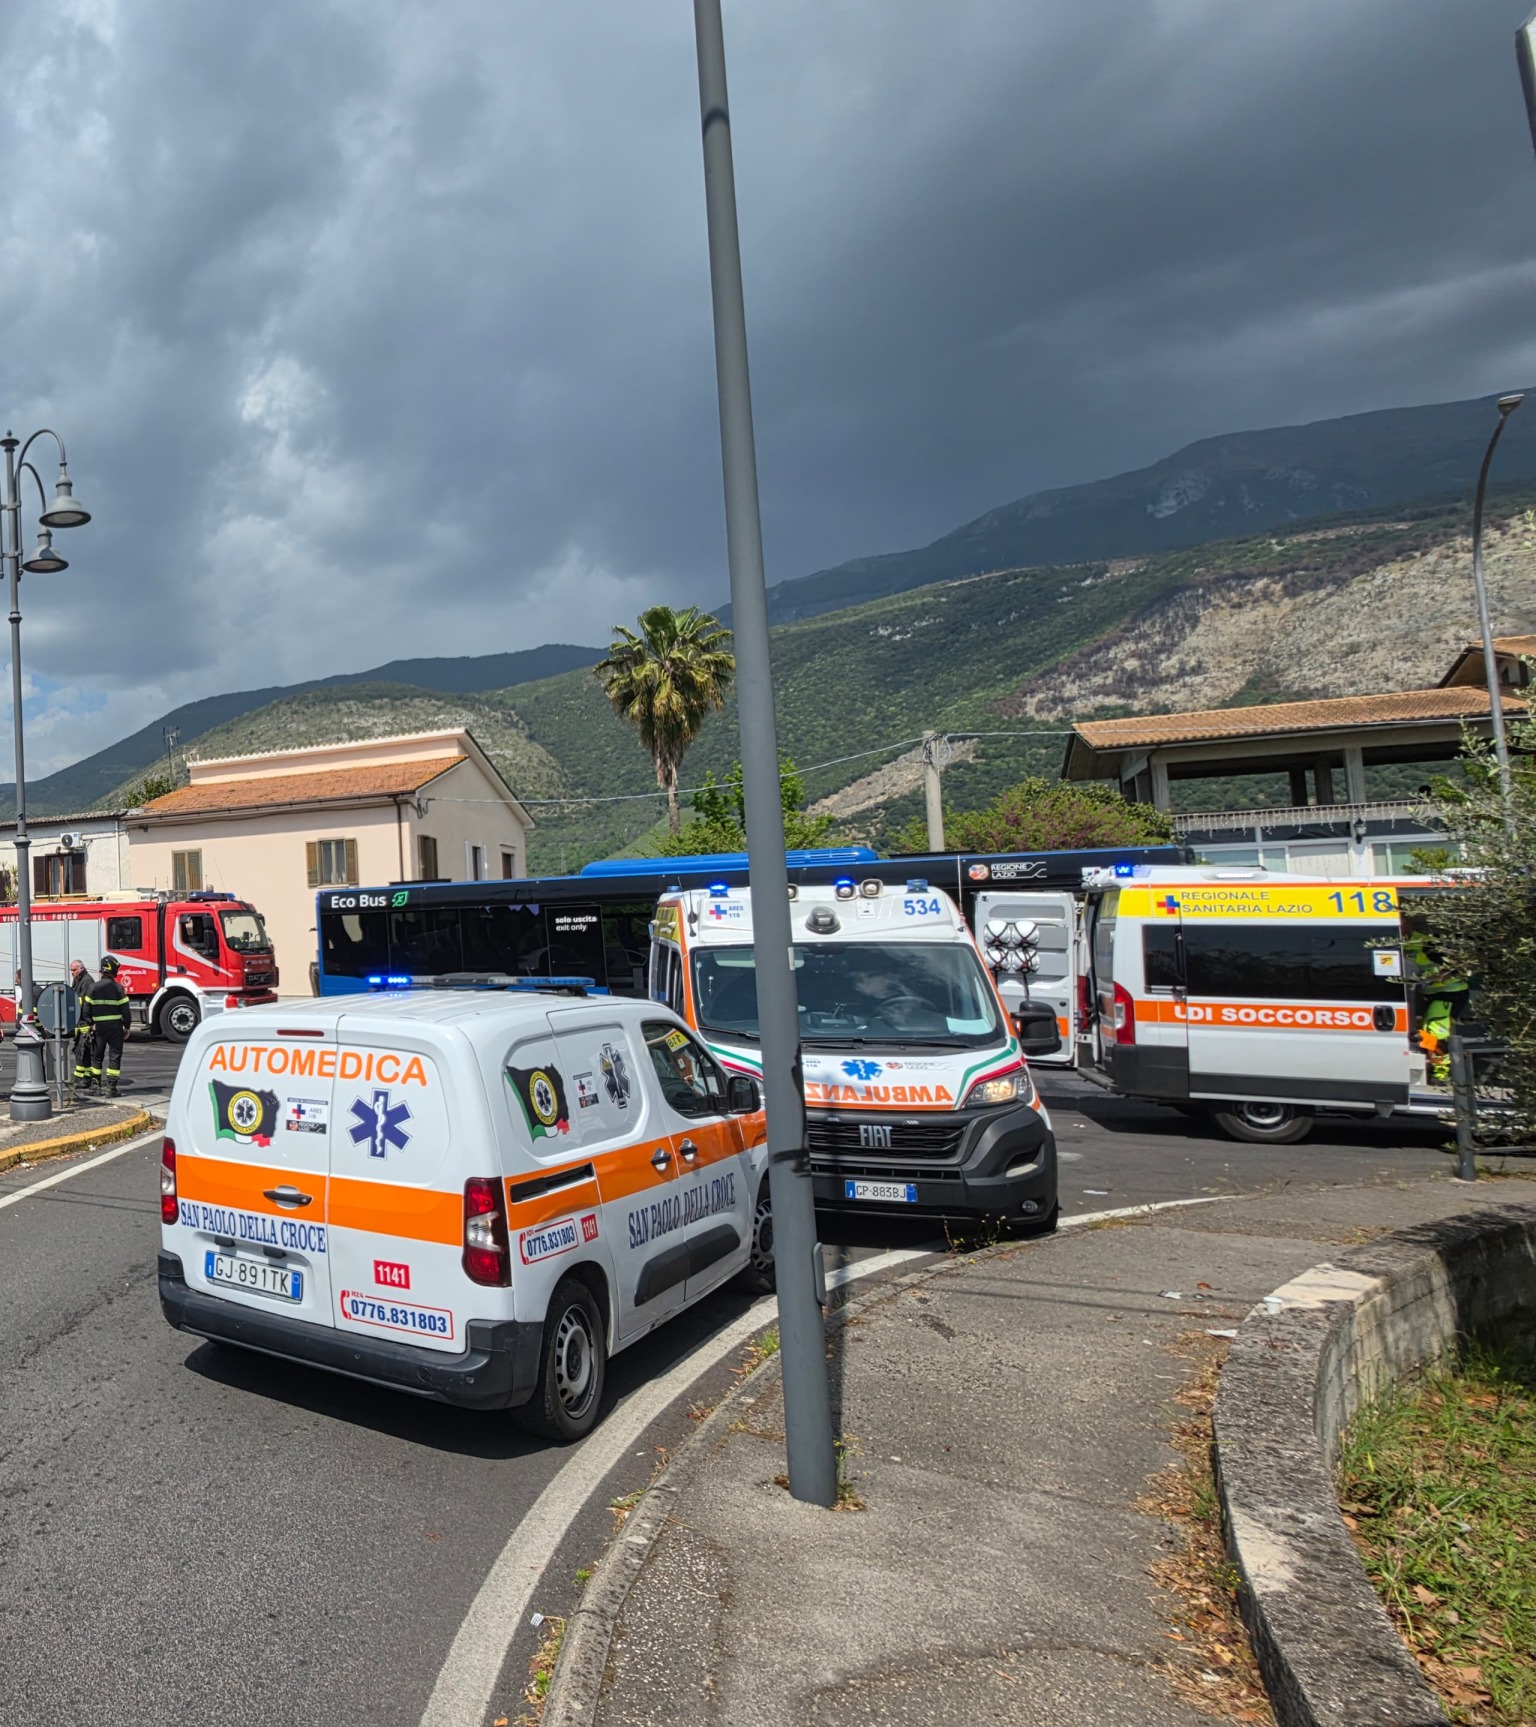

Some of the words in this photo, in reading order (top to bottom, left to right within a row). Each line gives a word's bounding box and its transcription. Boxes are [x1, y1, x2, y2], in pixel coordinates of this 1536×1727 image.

[991, 863, 1028, 871] REGIONE
[330, 895, 356, 909] Eco
[359, 894, 386, 908] Bus
[1181, 891, 1270, 901] REGIONALE
[1328, 890, 1393, 913] 118
[904, 899, 941, 916] 534
[1182, 904, 1263, 914] SANITARIA
[1266, 904, 1313, 914] LAZIO
[555, 915, 572, 924] solo
[572, 915, 597, 923] uscita
[555, 923, 570, 931] exit
[570, 923, 587, 932] only
[1221, 1007, 1372, 1027] SOCCORSO
[209, 1045, 427, 1087] AUTOMEDICA
[859, 1124, 893, 1148] FIAT
[628, 1207, 649, 1250] SAN
[650, 1195, 681, 1240] PAOLO
[683, 1184, 710, 1227] DELLA
[711, 1172, 736, 1214] CROCE
[180, 1200, 200, 1227] SAN
[202, 1206, 237, 1237] PAOLO
[238, 1213, 279, 1246] DELLA
[280, 1220, 327, 1253] CROCE
[583, 1218, 598, 1238] 1141
[526, 1225, 576, 1257] 0776.831803
[376, 1263, 406, 1286] 1141
[350, 1299, 448, 1334] 0776.831803
